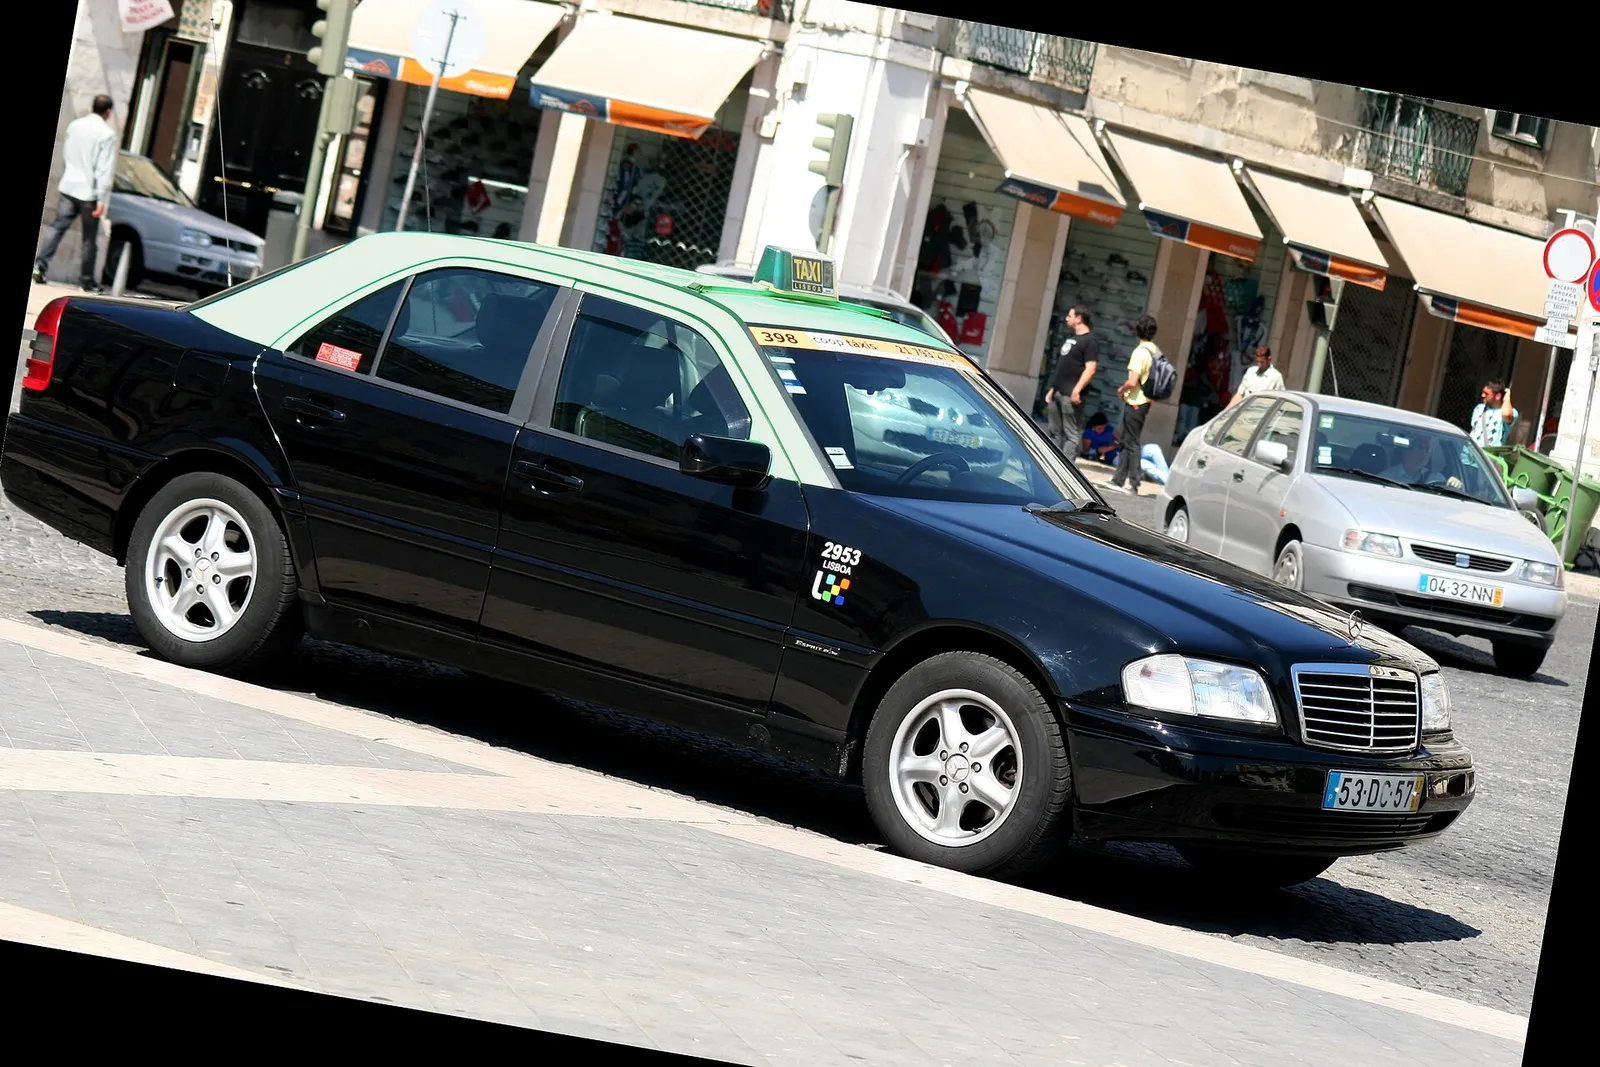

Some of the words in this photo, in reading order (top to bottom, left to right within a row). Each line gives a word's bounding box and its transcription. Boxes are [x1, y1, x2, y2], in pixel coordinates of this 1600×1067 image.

[793, 258, 821, 283] TAXI
[794, 283, 822, 293] LISBOA
[761, 331, 799, 345] 398
[821, 541, 862, 566] 2953
[822, 560, 852, 576] LISBOA
